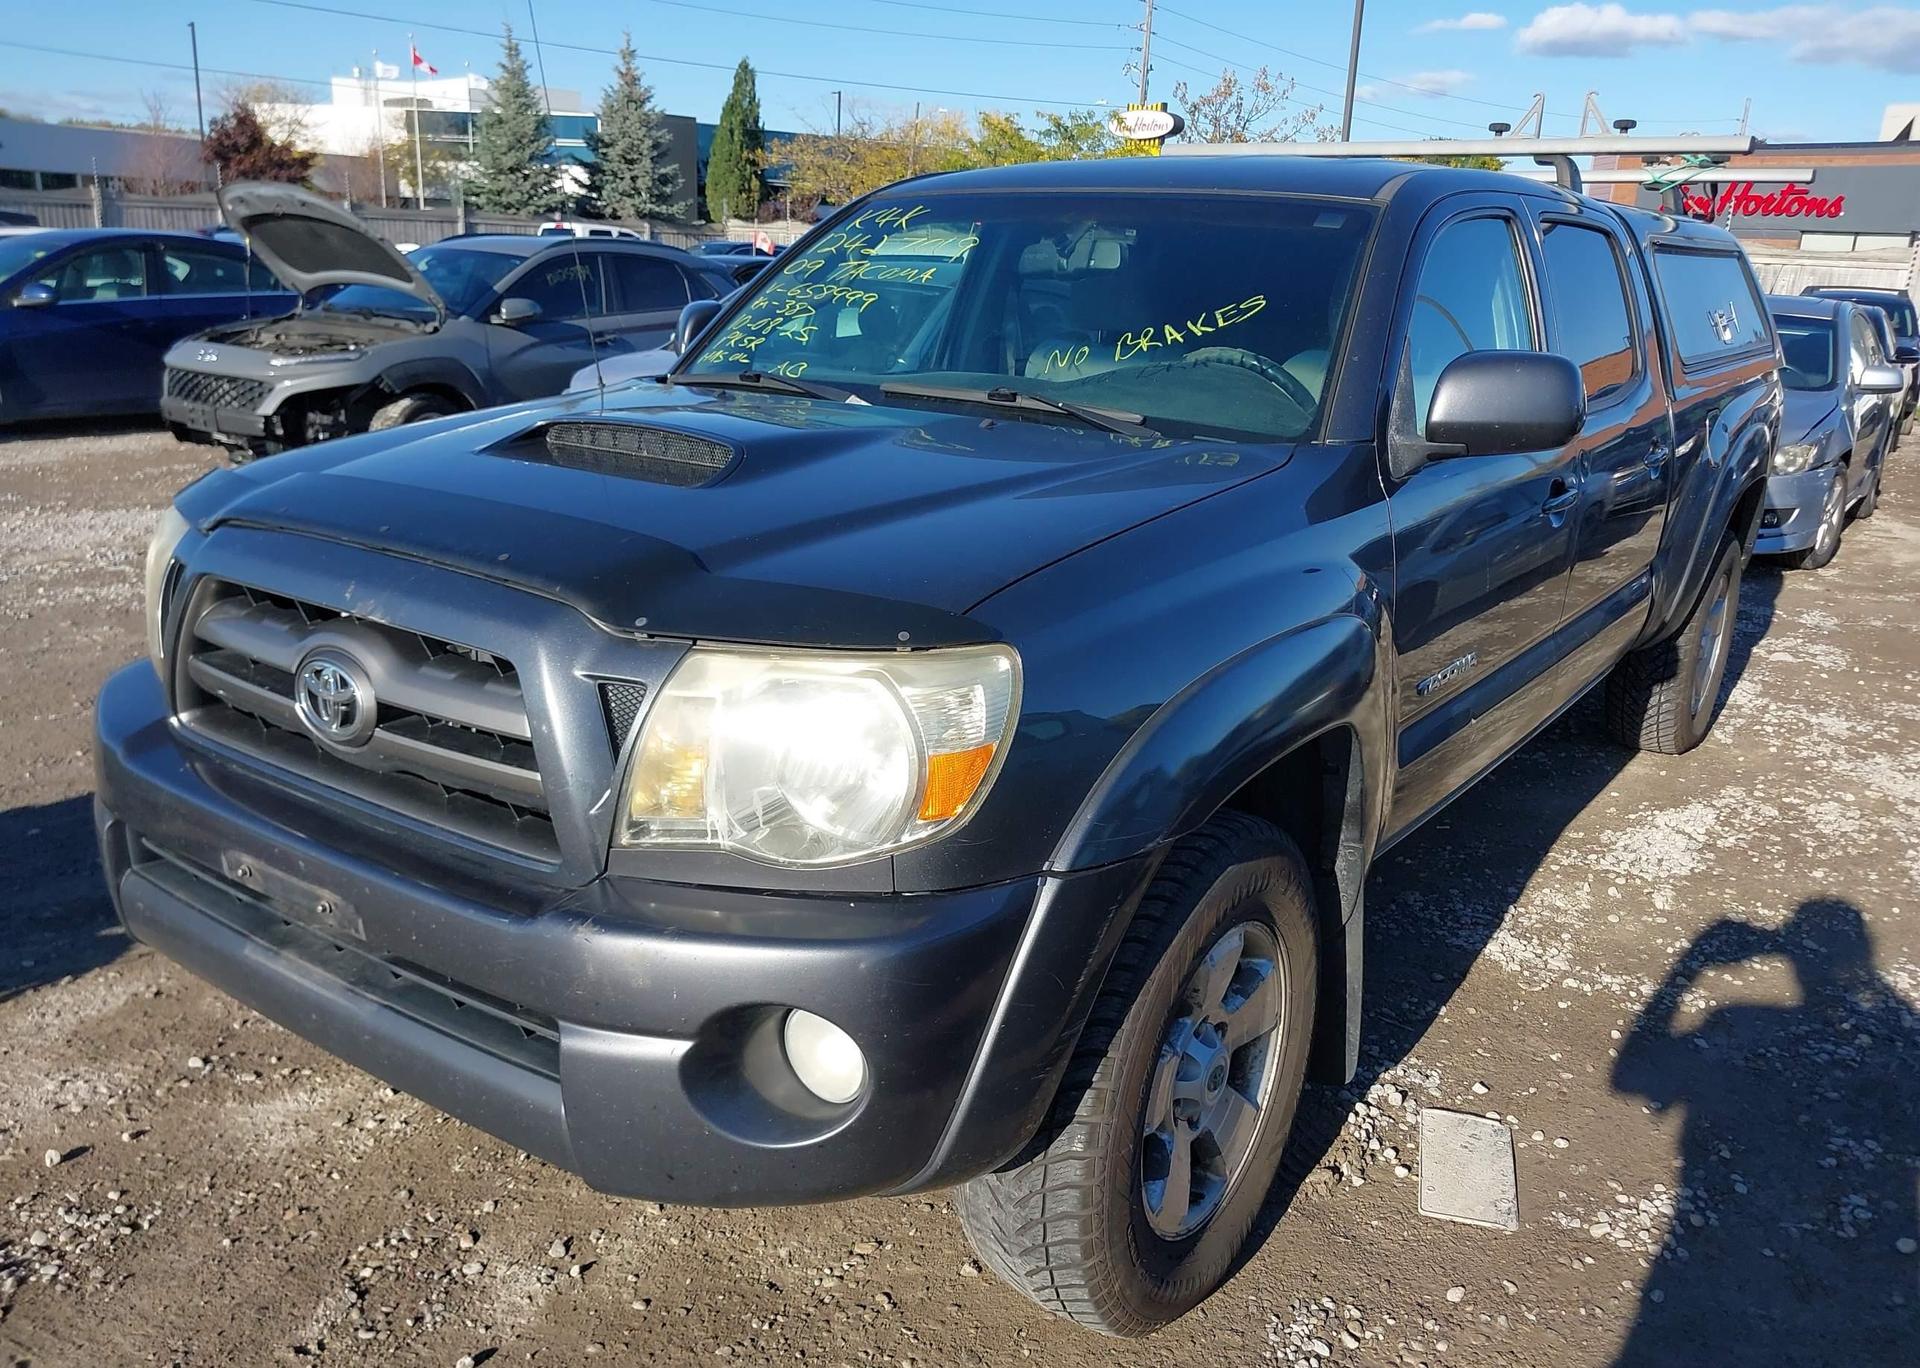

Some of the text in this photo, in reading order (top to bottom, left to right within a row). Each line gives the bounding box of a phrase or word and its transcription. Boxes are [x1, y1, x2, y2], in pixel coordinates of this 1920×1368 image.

[846, 205, 931, 231] K4K
[1716, 181, 1846, 219] Hortons
[783, 259, 937, 284] 09 TACOMA
[1044, 295, 1267, 374] NO BRAKES
[1416, 651, 1479, 696] TACOMA
